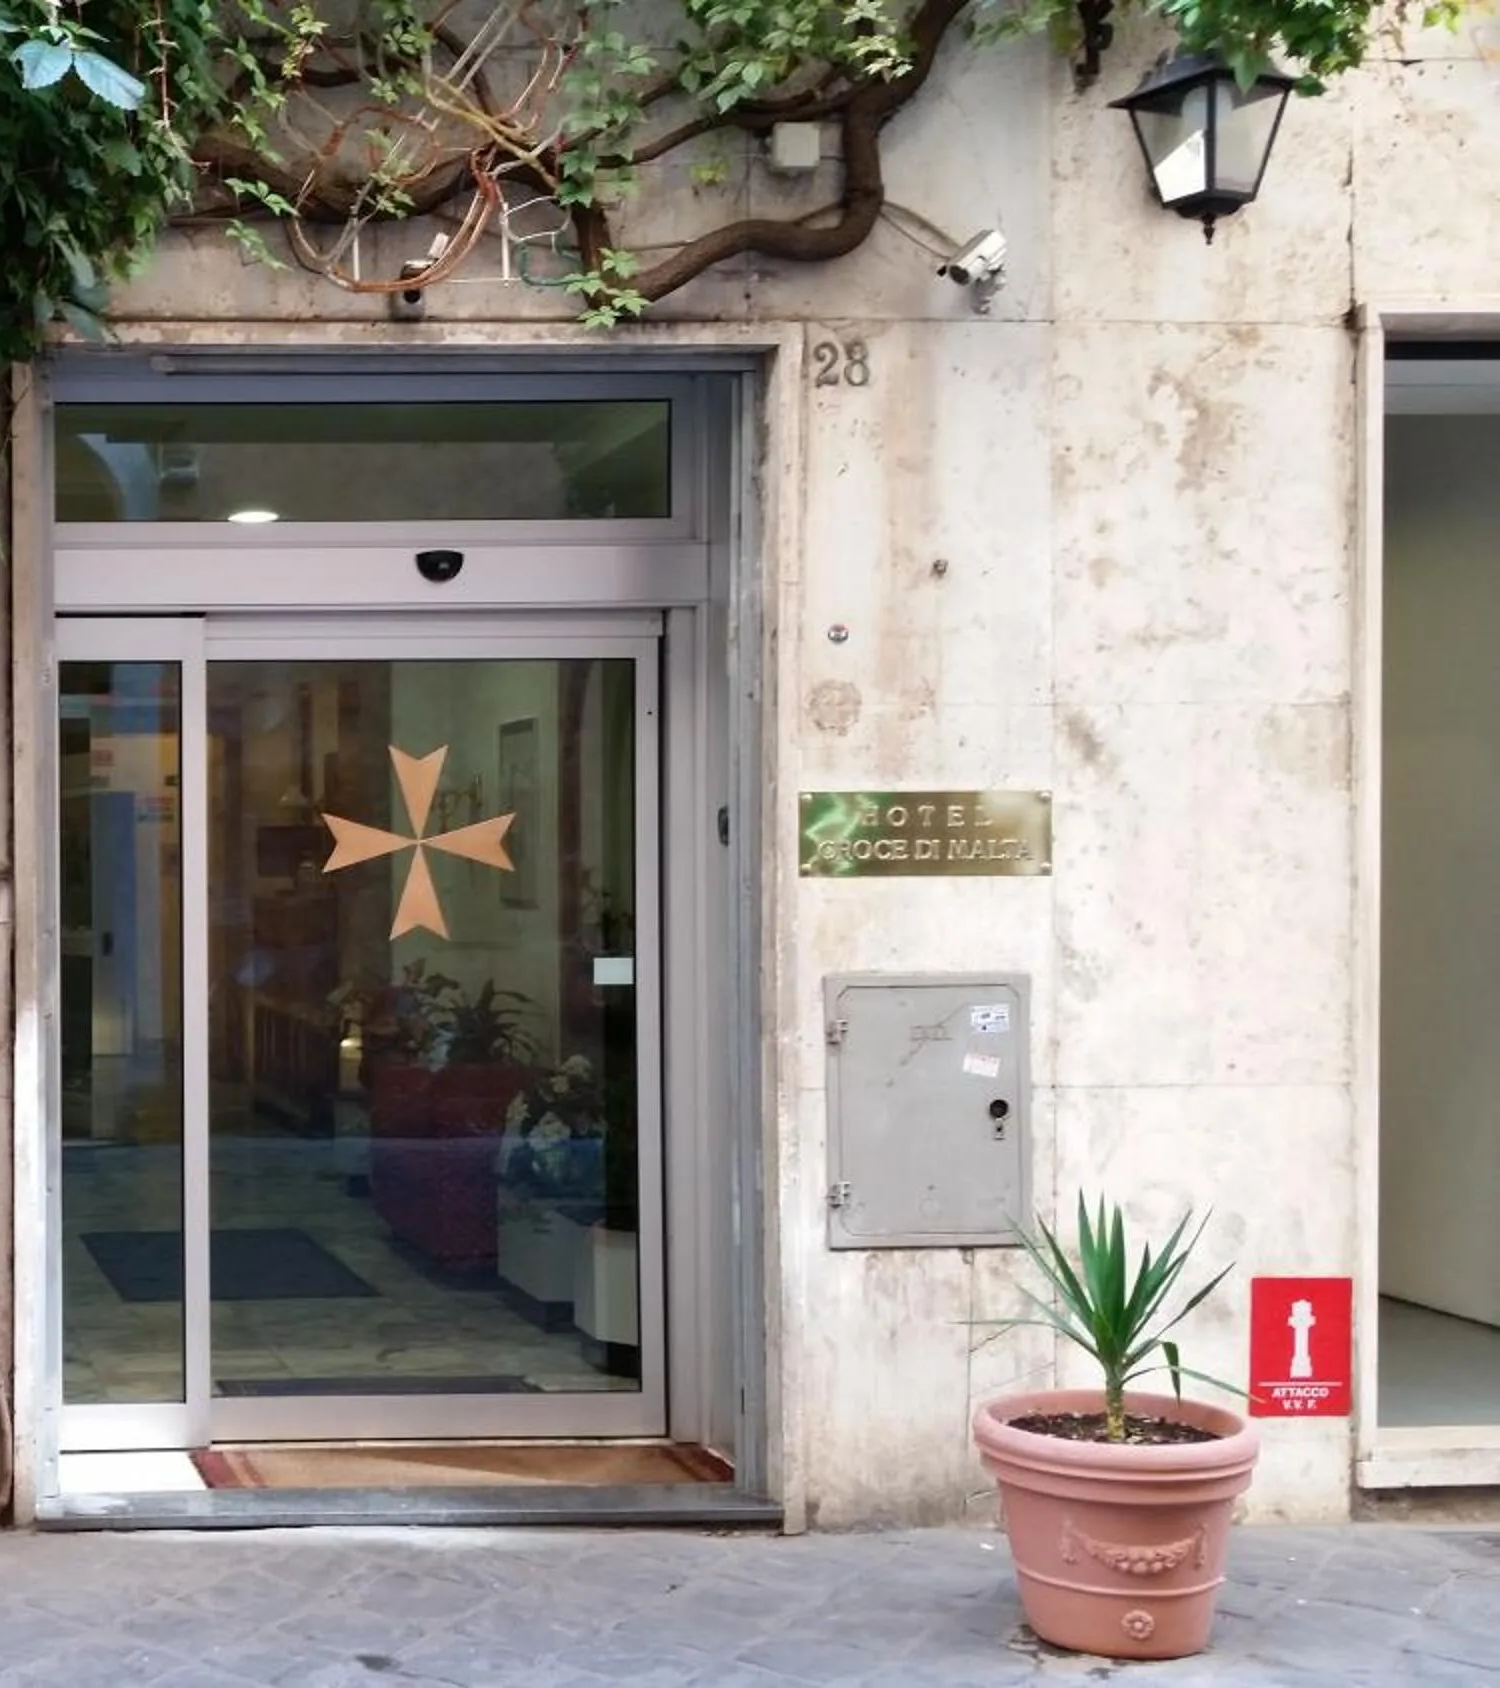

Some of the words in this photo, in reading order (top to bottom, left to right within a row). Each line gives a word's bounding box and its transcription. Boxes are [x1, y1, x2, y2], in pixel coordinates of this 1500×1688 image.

[813, 341, 870, 388] 28
[860, 805, 995, 827] HOTEL
[818, 839, 910, 861] CROCE
[913, 839, 941, 861] DI
[947, 839, 1036, 861] MALTA
[1271, 1387, 1329, 1398] ATTACCO
